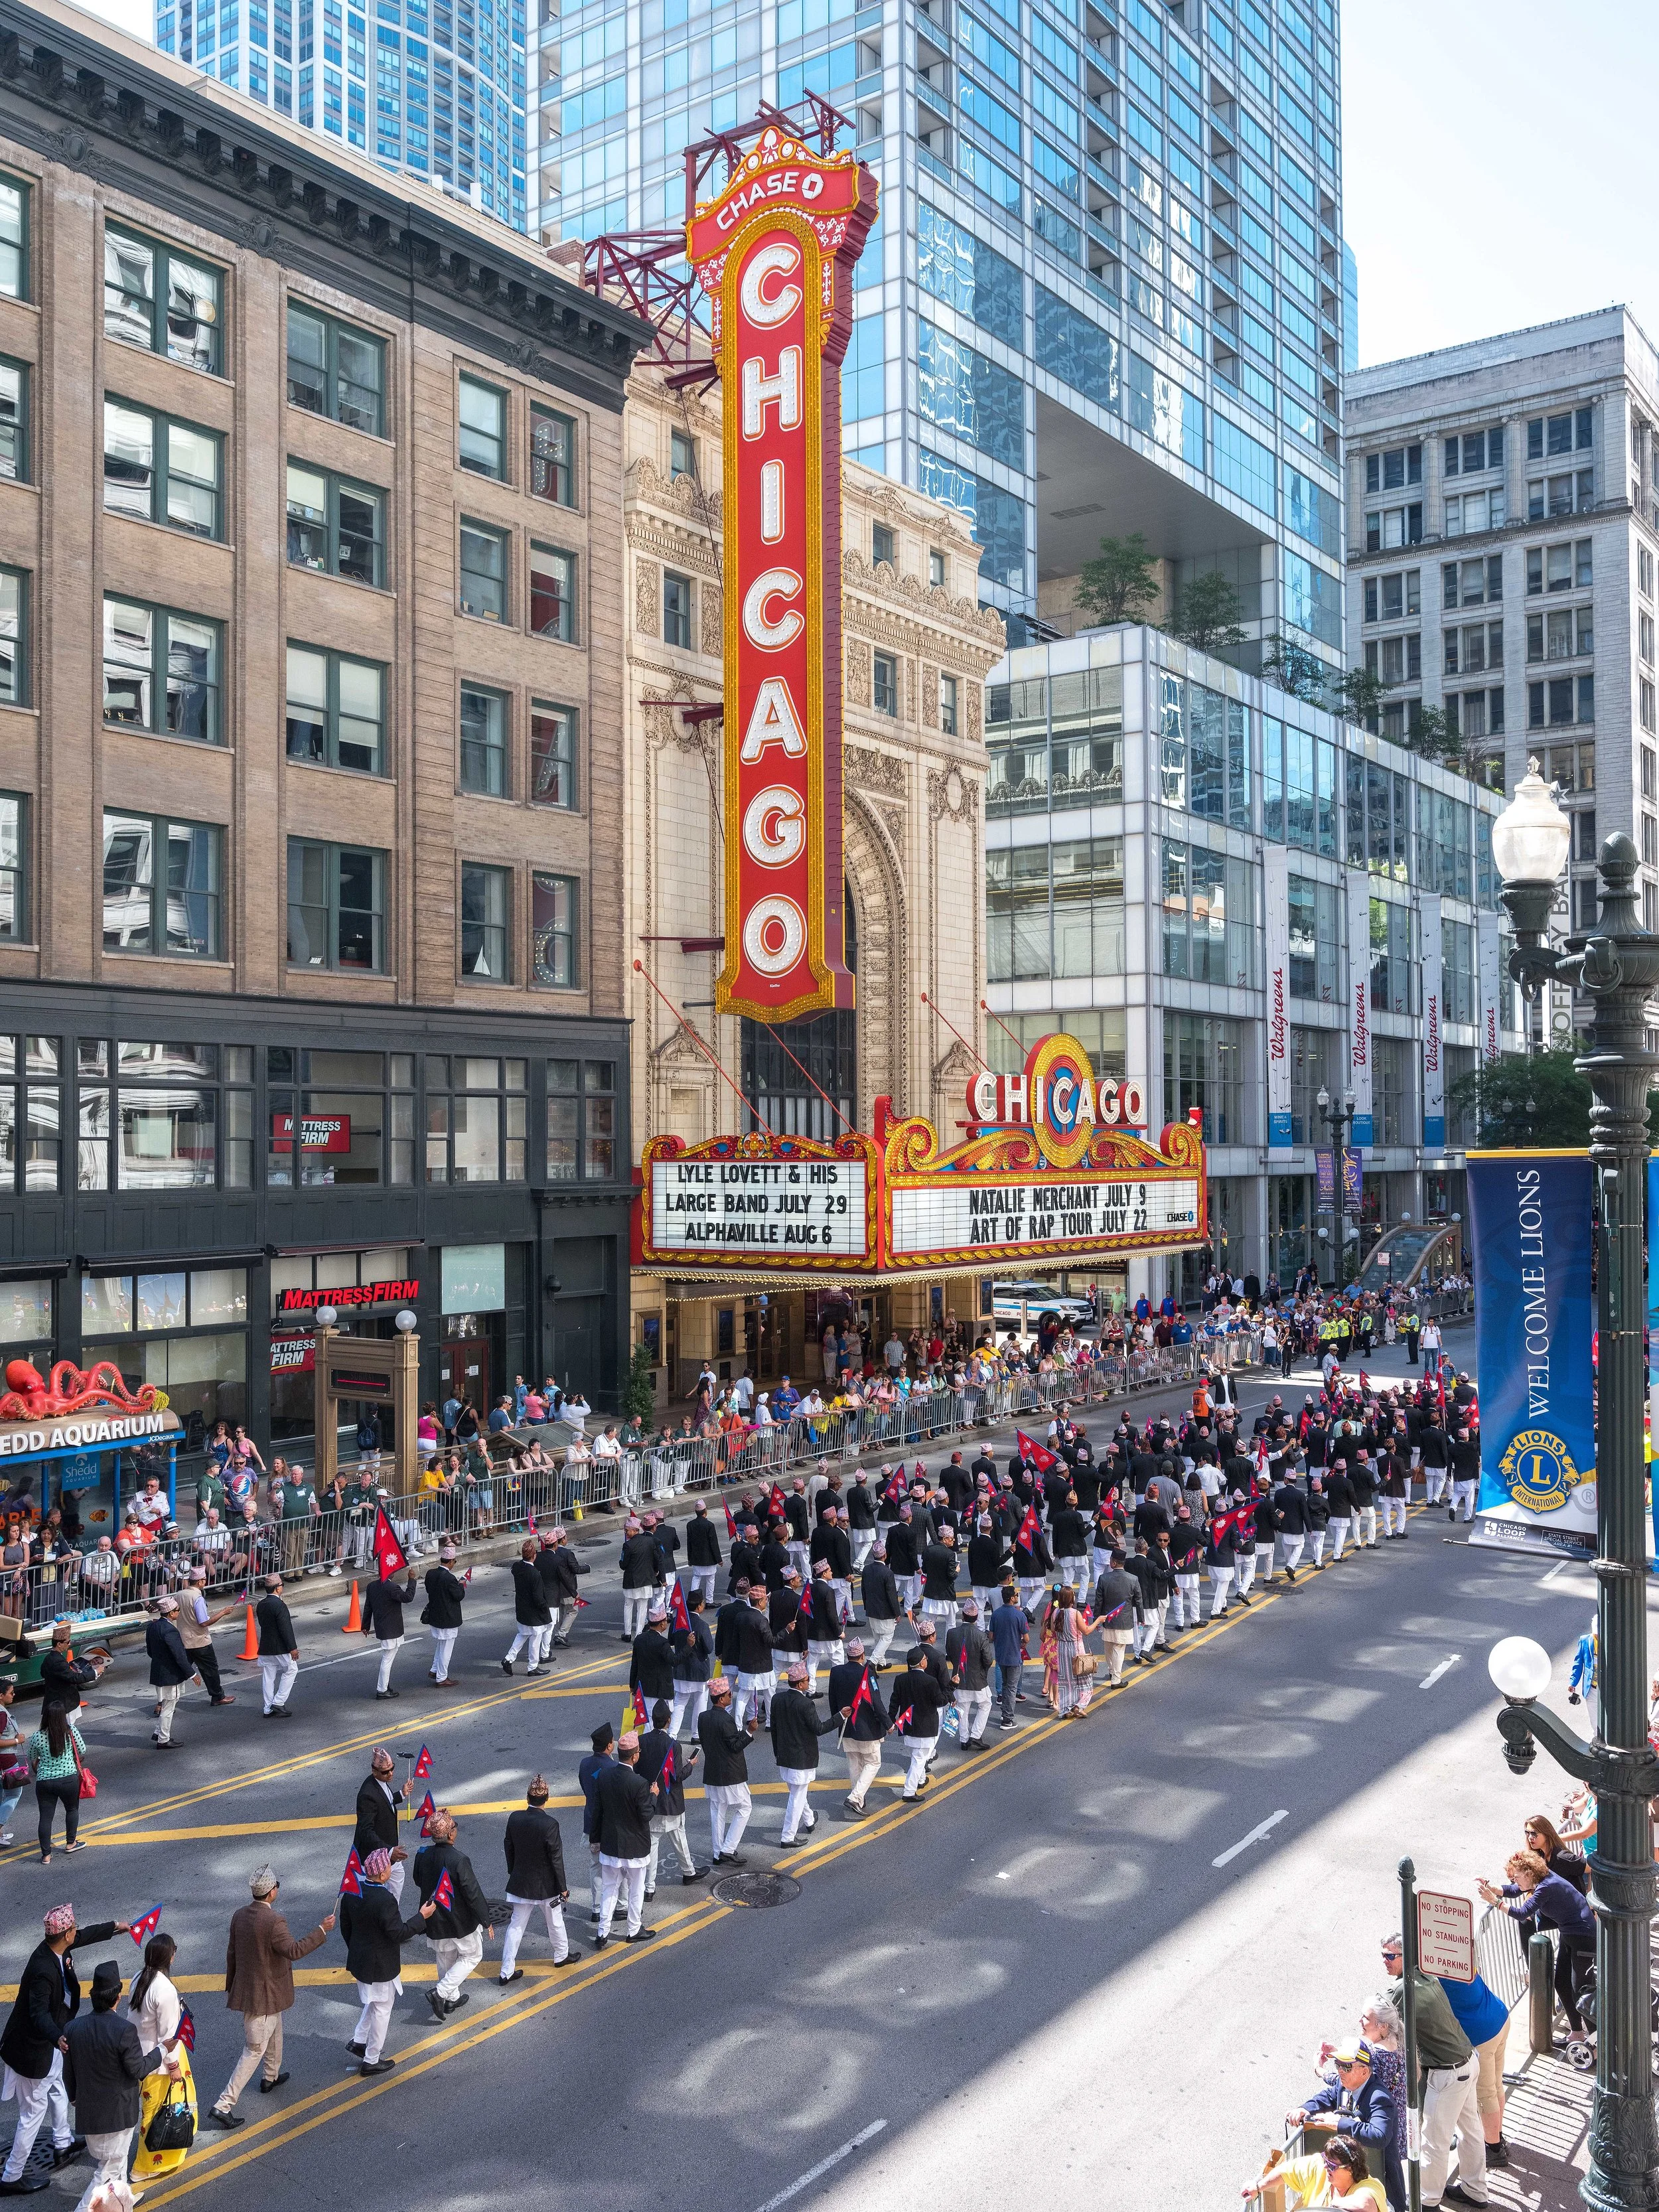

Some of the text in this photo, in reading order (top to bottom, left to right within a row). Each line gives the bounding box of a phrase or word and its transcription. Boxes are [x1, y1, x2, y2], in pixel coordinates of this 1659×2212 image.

[716, 172, 800, 230] CHASE
[740, 243, 808, 978] CHICAGO
[1551, 925, 1571, 1047] JOFFY
[1269, 968, 1288, 1061] Walgreens
[1352, 982, 1370, 1067] Walgreens
[1425, 995, 1441, 1073] Walgreens
[1485, 1007, 1499, 1066] algreens
[974, 1071, 1145, 1124] CHICAGO
[284, 1118, 341, 1132] MTTRESS
[678, 1165, 838, 1184] LYLE LOVETT & HIS
[666, 1193, 847, 1215] LARGE BAND JULY 29
[970, 1183, 1147, 1215] NATALIE MERCHANT JULY 9
[970, 1208, 1148, 1244] ART OF RAP TOUR JULY 22
[1167, 1213, 1189, 1223] CHASE
[685, 1222, 833, 1244] ALPHAVILLE AUG 6
[1517, 1169, 1550, 1419] WELCOME LIONS
[270, 1339, 316, 1353] ATTRESS
[271, 1351, 305, 1366] FIRM
[0, 1414, 165, 1455] EDD AQUARIUM
[1517, 1432, 1563, 1453] LIONS
[66, 1463, 97, 1479] Shedd
[1530, 1454, 1551, 1485] L
[1515, 1489, 1563, 1508] INTERNATIONAL
[1498, 1528, 1526, 1537] LOOP
[1499, 1522, 1526, 1531] CHICAGO
[74, 1538, 99, 1549] AQUAR
[1421, 1902, 1469, 1919] NO STOPPING
[1422, 1928, 1469, 1945] NO STANDING
[1424, 1954, 1469, 1972] NO PARKING
